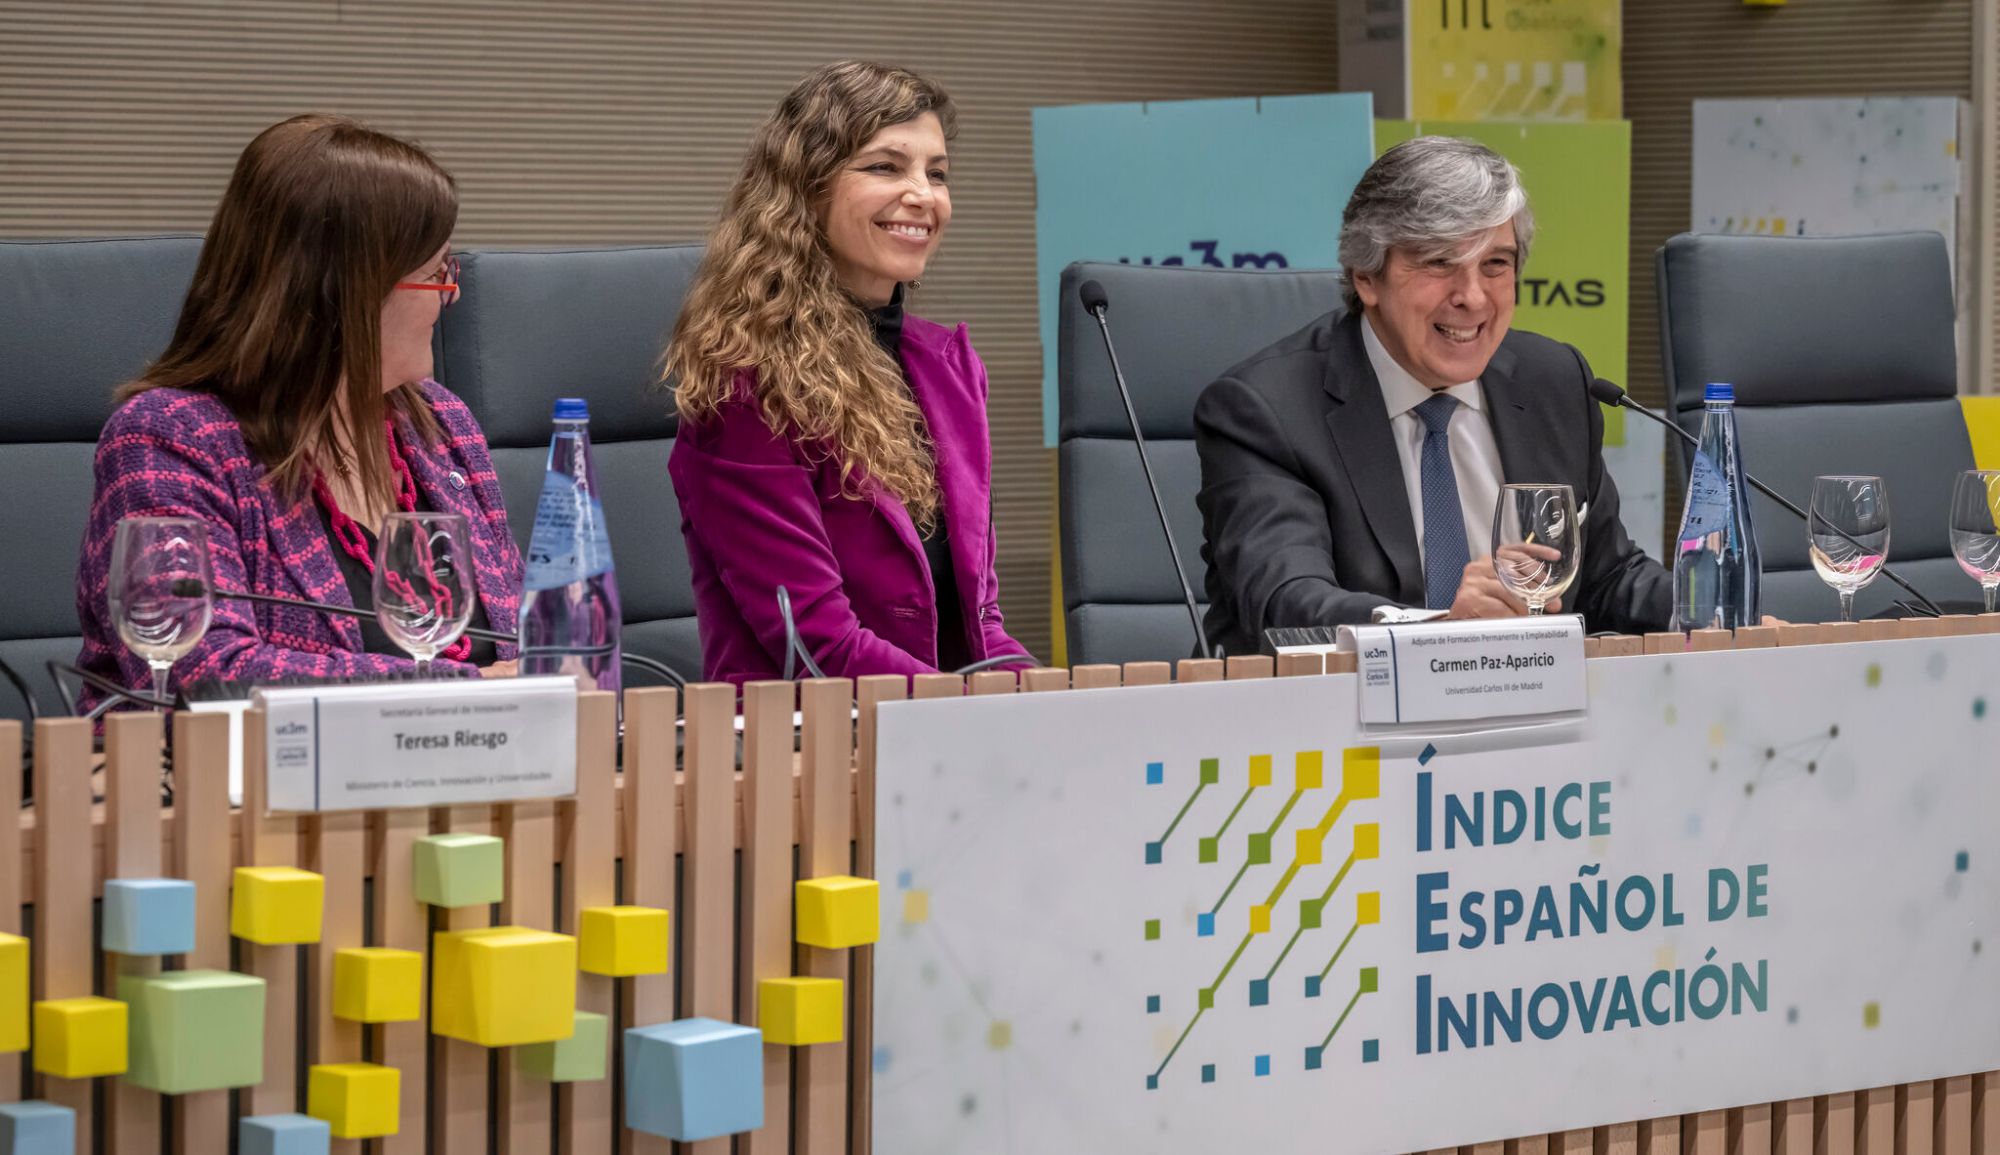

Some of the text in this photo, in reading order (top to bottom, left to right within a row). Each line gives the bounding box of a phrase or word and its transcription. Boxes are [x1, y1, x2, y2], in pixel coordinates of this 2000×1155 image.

[1411, 636, 1437, 647] Adjunta
[1438, 636, 1446, 645] de
[1447, 634, 1481, 645] Formación
[1482, 633, 1520, 643] Permanente
[1526, 630, 1569, 641] Empleabilidad
[1365, 648, 1388, 659] uc3m
[1430, 652, 1555, 673] Carmen Paz-Aparicio
[1445, 685, 1483, 695] Universidad
[1484, 683, 1503, 693] Carlos
[1512, 682, 1519, 691] de
[1520, 681, 1543, 691] Madrid
[394, 729, 508, 751] Teresa Riesgo
[1415, 743, 1612, 853] ÍNDICE
[1415, 863, 1770, 954] ESPAÑOL DE
[1415, 945, 1770, 1055] INNOVACIÓN
